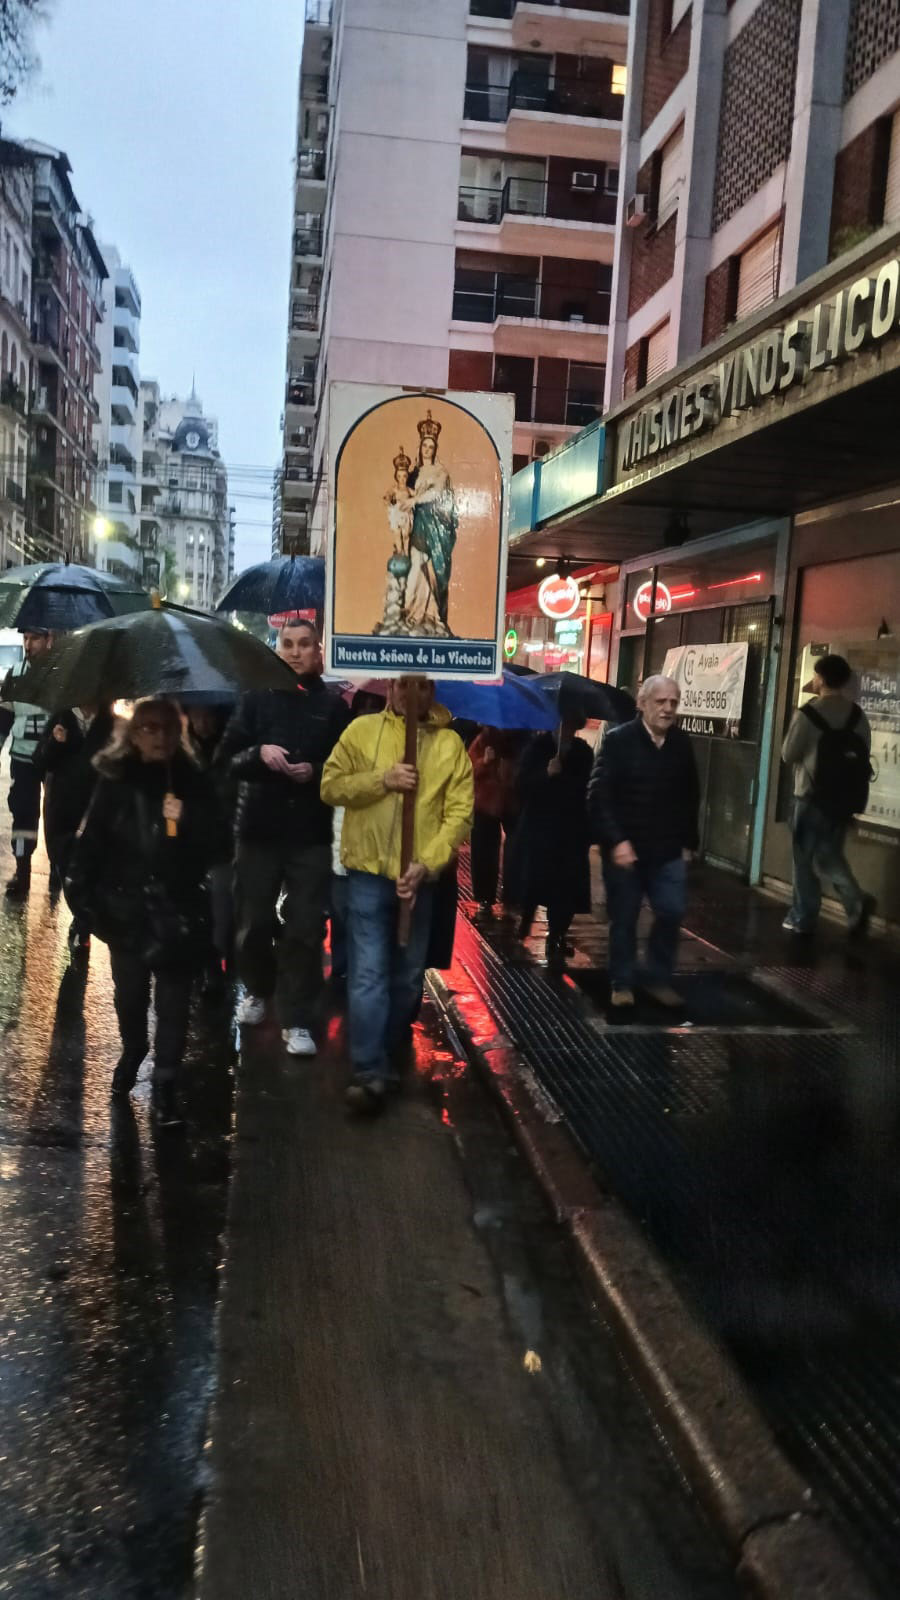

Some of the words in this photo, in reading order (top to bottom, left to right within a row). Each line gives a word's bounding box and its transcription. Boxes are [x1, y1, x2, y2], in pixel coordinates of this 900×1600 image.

[622, 382, 706, 471] WHISKIES
[719, 320, 804, 417] VINOS
[810, 259, 900, 371] LICO
[337, 646, 378, 662] Nuestra
[380, 648, 414, 664] Señora
[416, 647, 428, 664] de
[431, 648, 445, 665] las
[447, 650, 492, 666] Victorias
[697, 652, 719, 672] Ayala
[681, 717, 715, 735] ALQUILA
